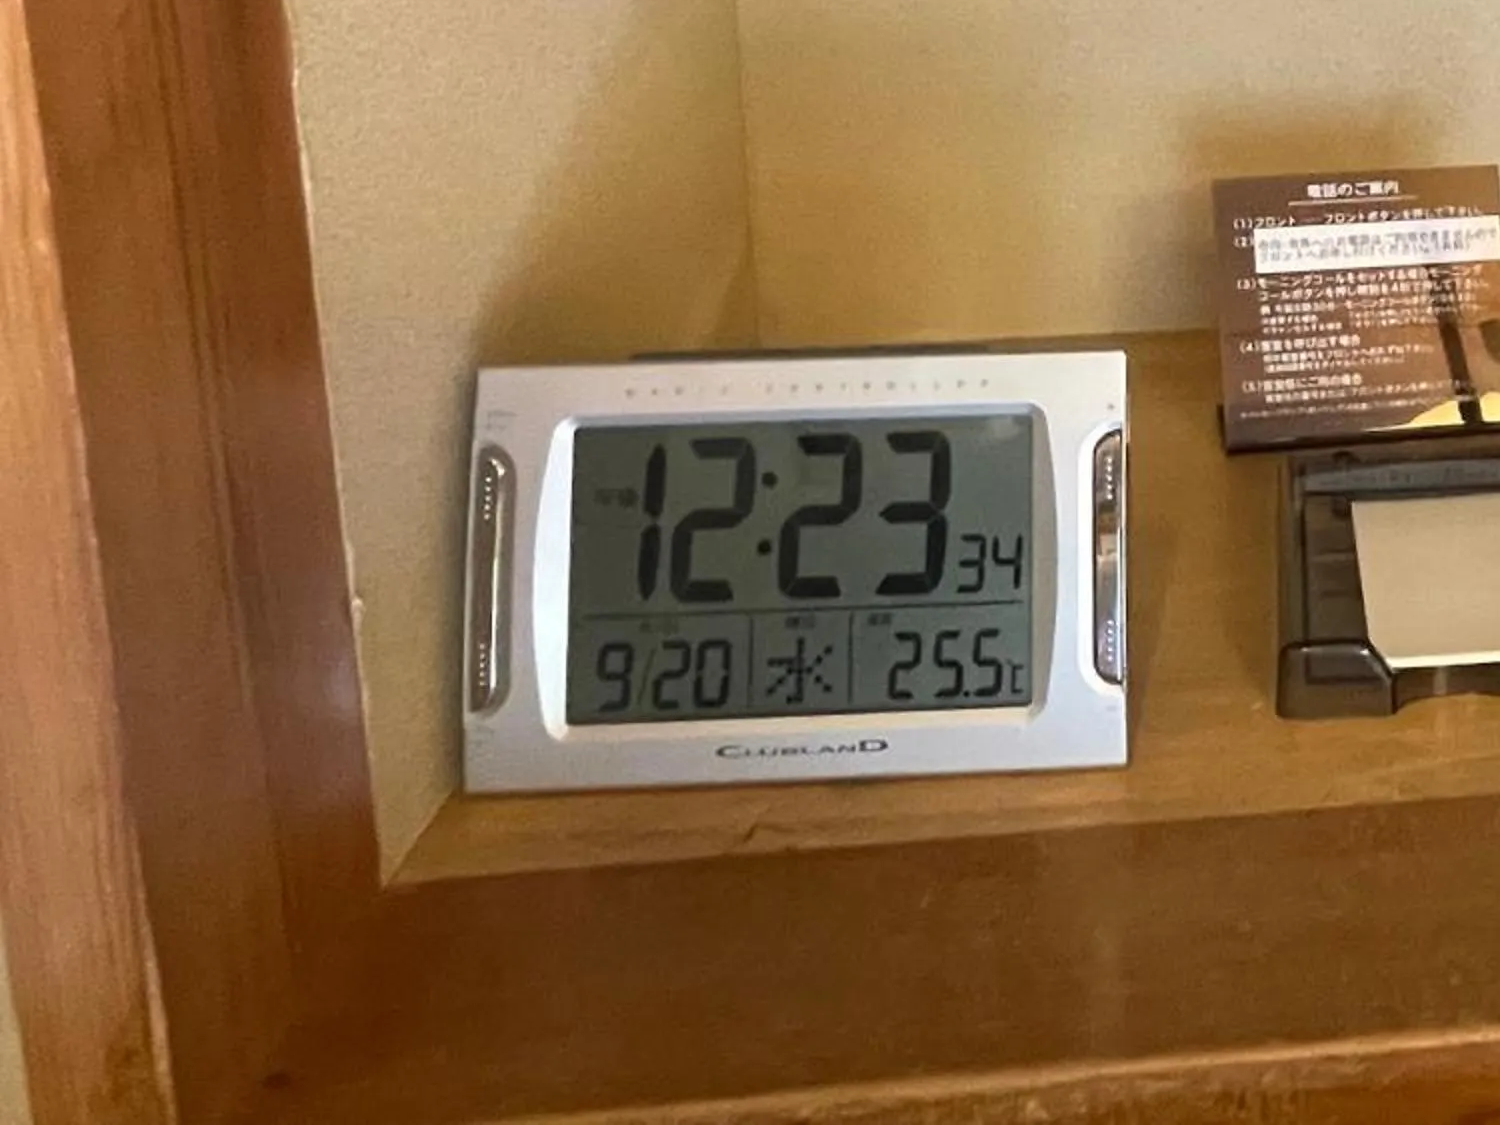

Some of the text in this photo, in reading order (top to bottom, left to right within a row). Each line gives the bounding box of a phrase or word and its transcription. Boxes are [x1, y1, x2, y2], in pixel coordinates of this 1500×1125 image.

[637, 431, 1023, 603] 12:23 34
[765, 637, 834, 704] 水
